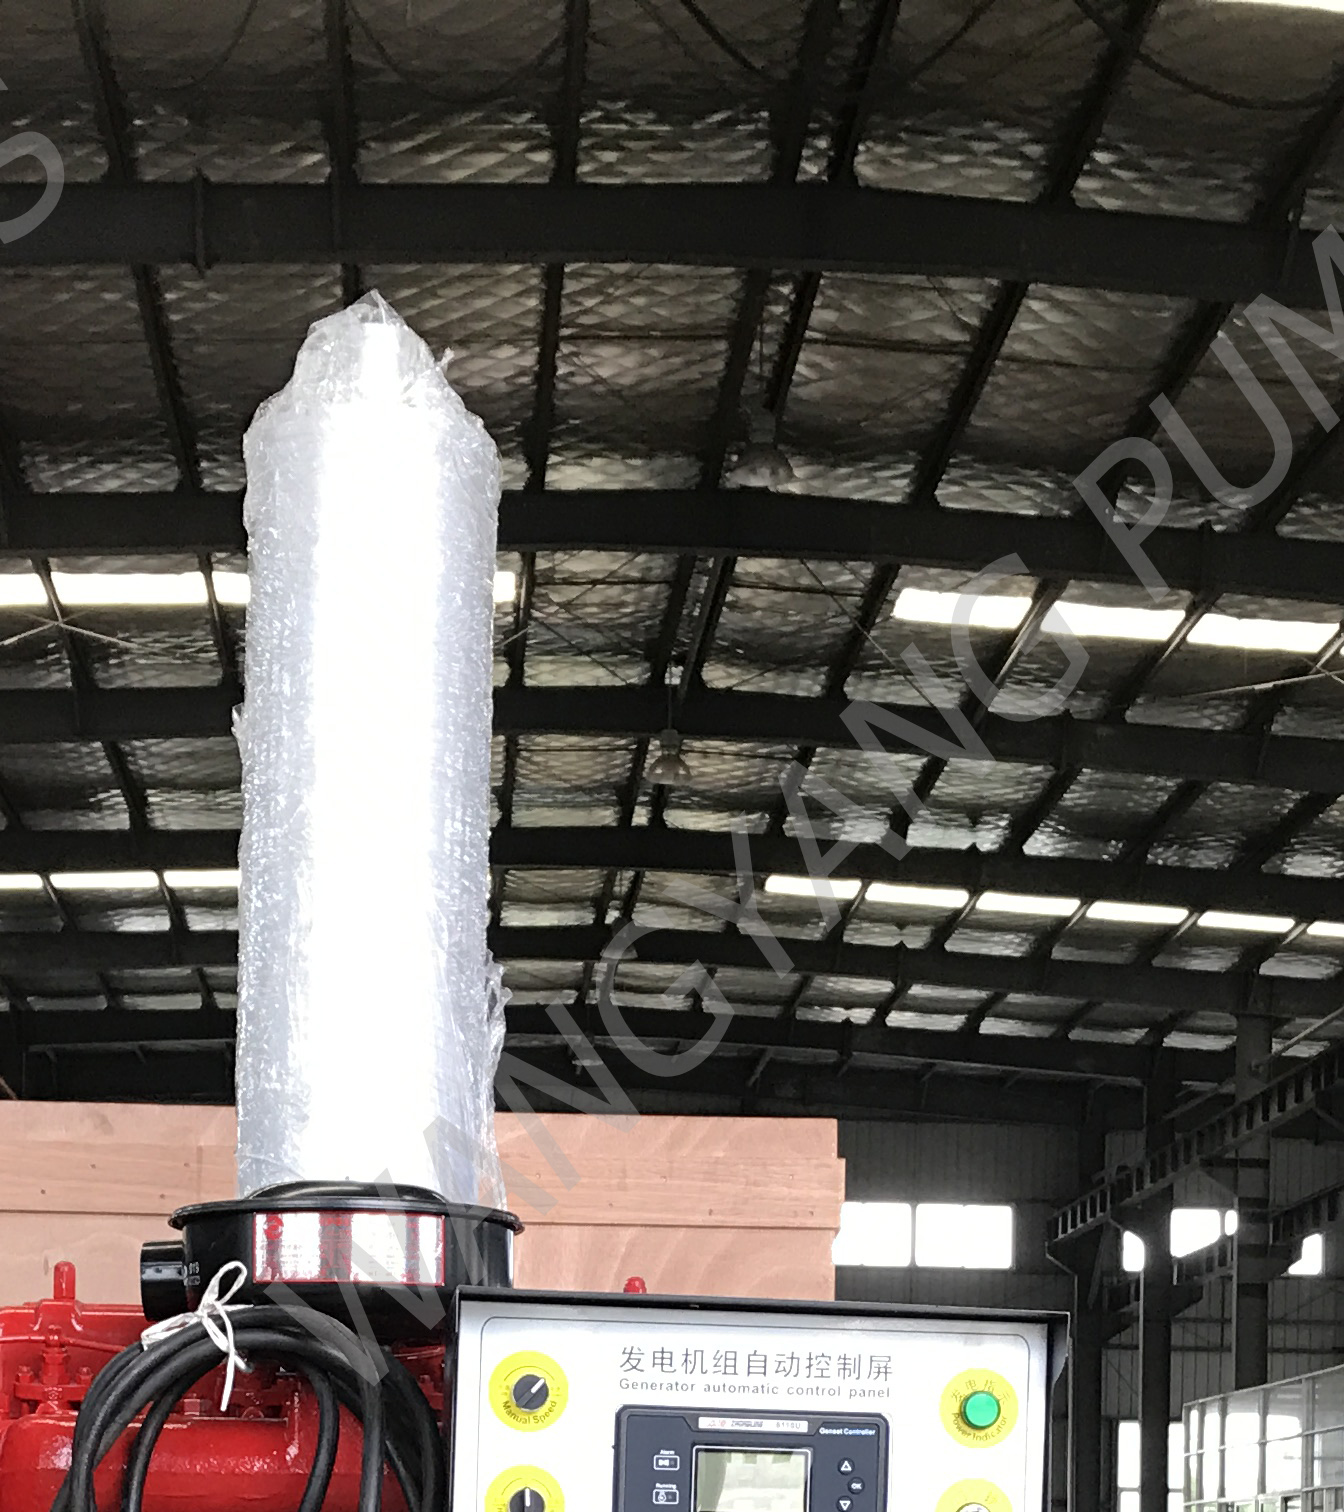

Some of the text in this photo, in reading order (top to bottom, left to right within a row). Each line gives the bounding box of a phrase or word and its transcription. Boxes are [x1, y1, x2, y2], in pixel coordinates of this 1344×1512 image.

[619, 1346, 893, 1382] 发电机组自动控制屏
[619, 1378, 891, 1399] Generator automatic control panel
[502, 1400, 557, 1424] Manual Speed
